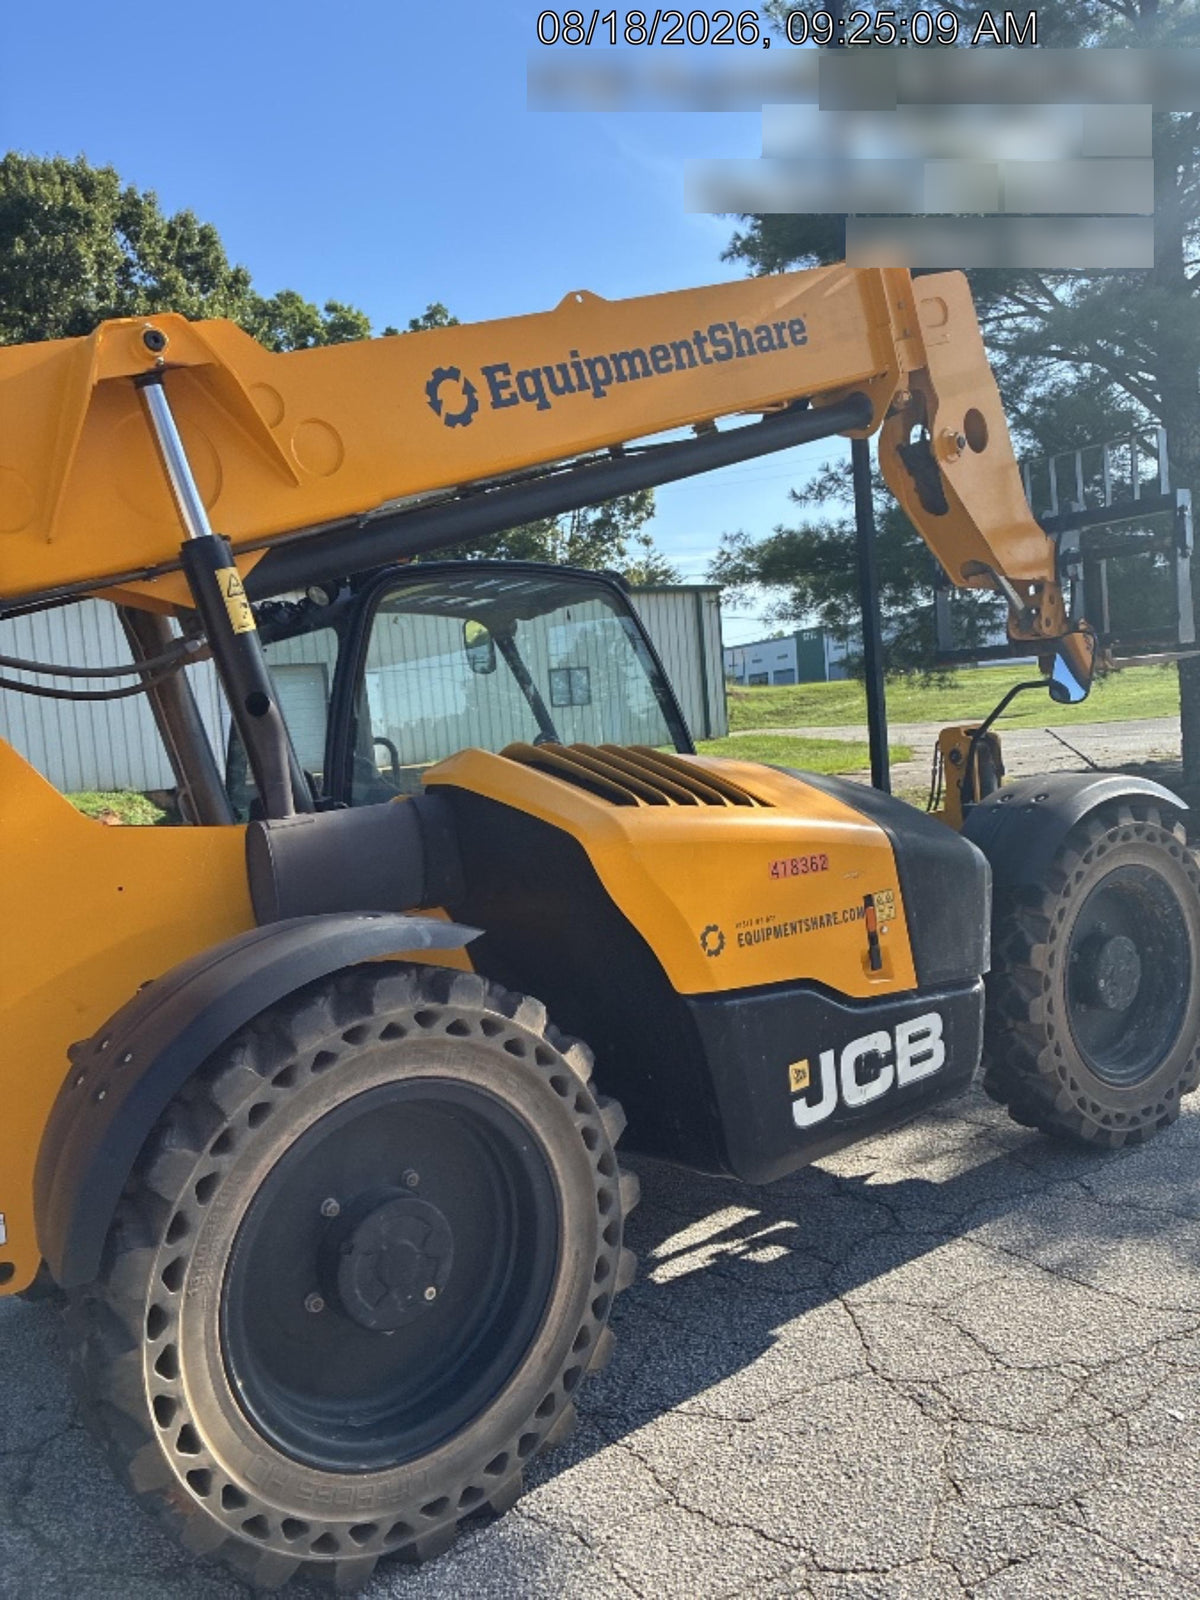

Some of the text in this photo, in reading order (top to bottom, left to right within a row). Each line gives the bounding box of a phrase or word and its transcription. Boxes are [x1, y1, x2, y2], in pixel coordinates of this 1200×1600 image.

[481, 316, 808, 410] EquipmentShare
[771, 854, 828, 879] 418362
[737, 905, 865, 948] EQUIPMENTSHARE.COM
[792, 1012, 945, 1127] JCB
